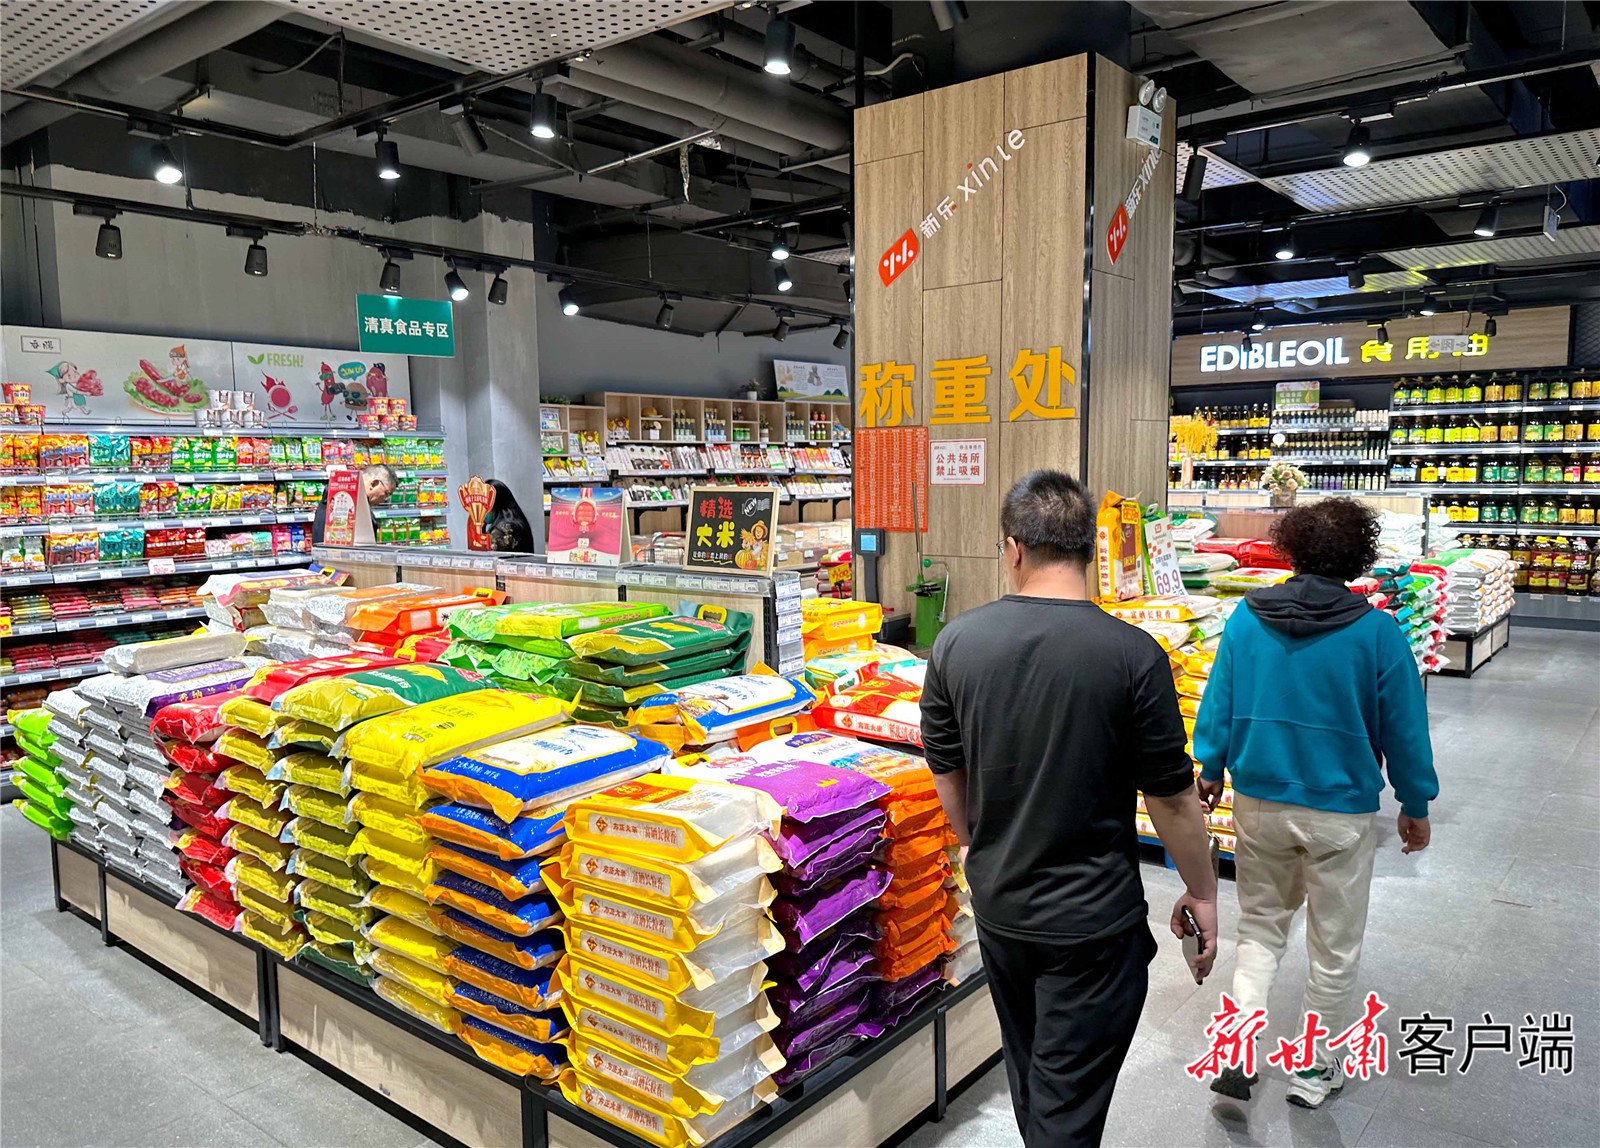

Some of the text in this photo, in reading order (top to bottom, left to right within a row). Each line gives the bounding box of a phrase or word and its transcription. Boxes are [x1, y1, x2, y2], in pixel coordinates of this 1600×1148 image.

[956, 128, 1026, 202] xinle
[364, 316, 449, 338] 清真食品专区
[267, 353, 304, 368] FRESH!
[1200, 336, 1350, 373] EDIBLEOIL
[859, 346, 1076, 428] 称重处
[936, 452, 980, 464] 公共场所
[936, 465, 980, 476] 禁止吸烟
[699, 497, 733, 519] 精选
[743, 498, 757, 515] NEW
[696, 521, 735, 548] 大米
[1156, 569, 1180, 596] 69.9
